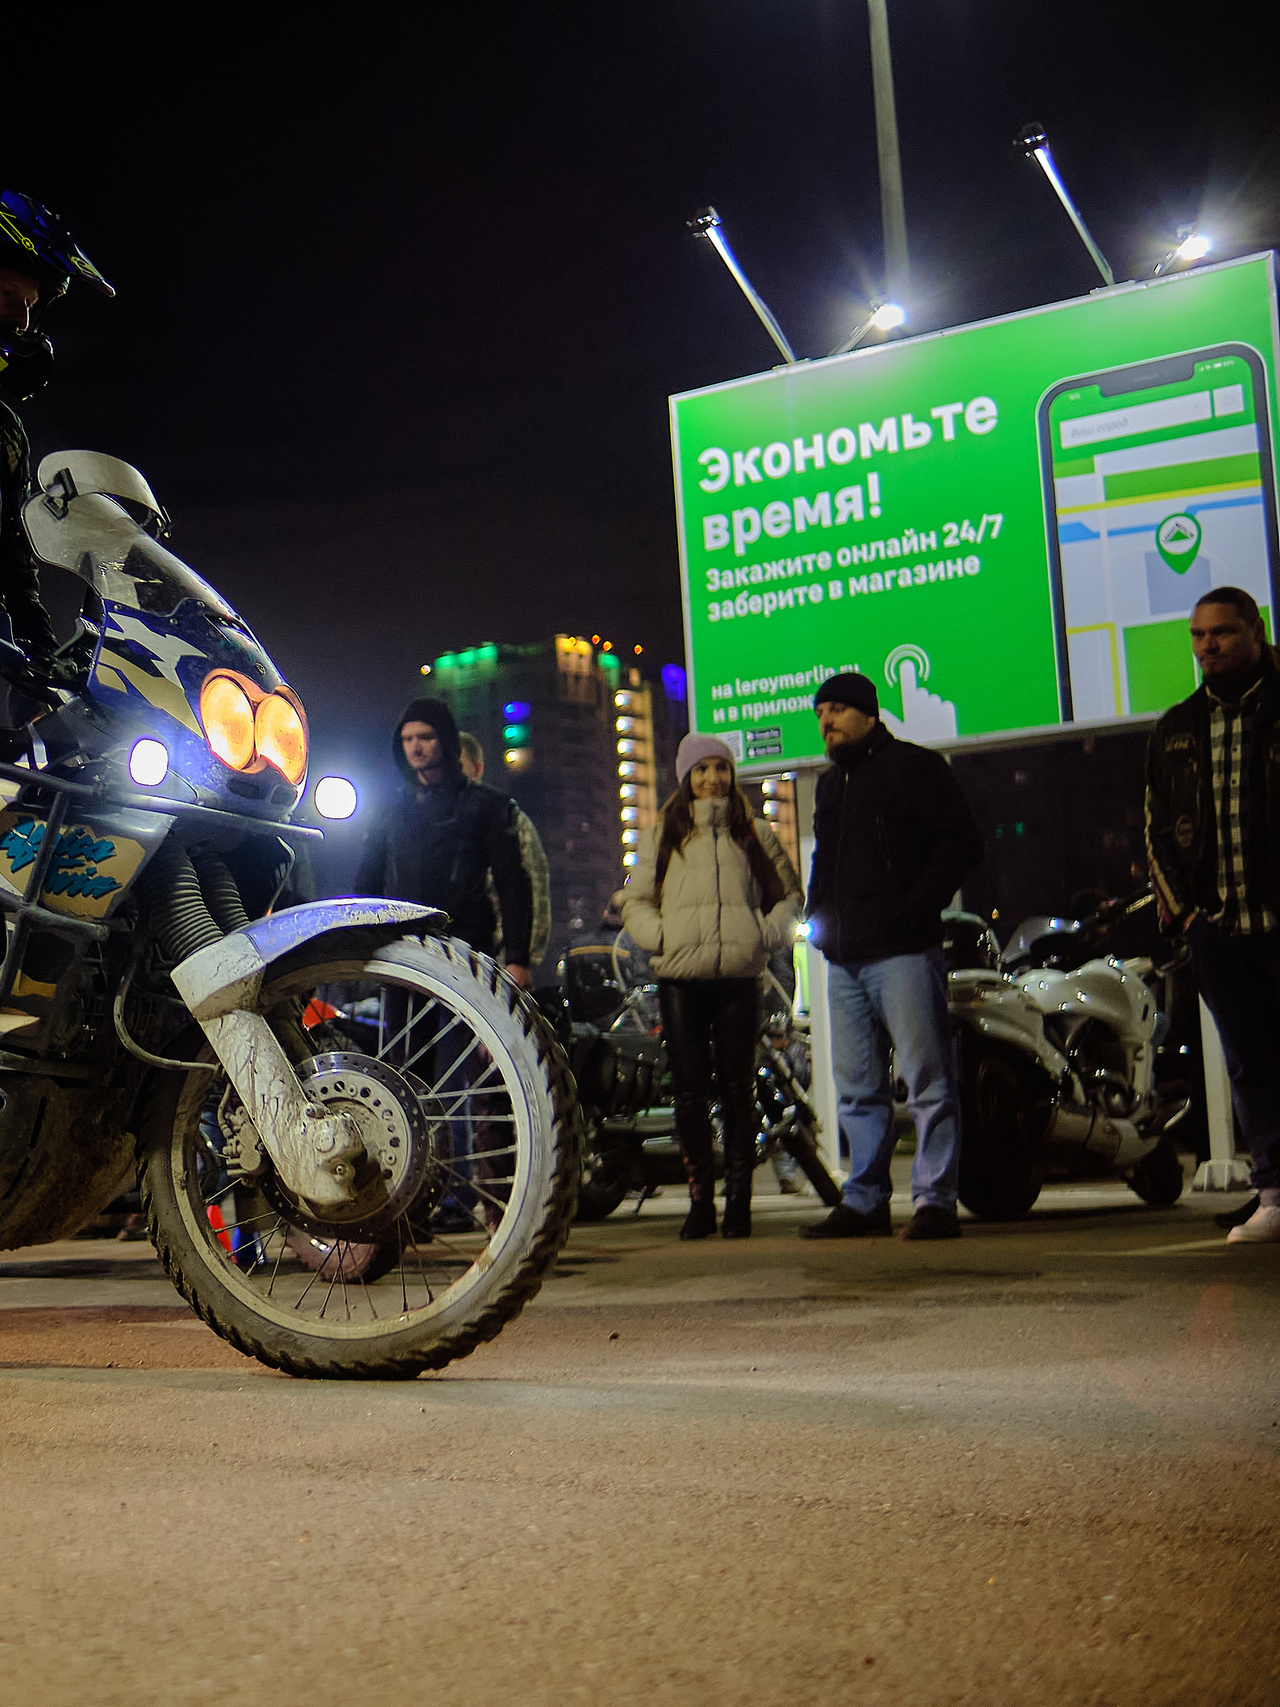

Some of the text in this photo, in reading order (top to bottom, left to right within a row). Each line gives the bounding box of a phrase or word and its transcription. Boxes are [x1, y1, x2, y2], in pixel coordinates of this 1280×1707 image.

[698, 396, 998, 493] Экономьте
[702, 471, 882, 556] время!
[705, 513, 1004, 592] Закажите онлайн 24/7
[707, 555, 981, 622] заберите в магазине
[711, 663, 860, 700] на leroymerlinru
[713, 694, 816, 724] и в прилож
